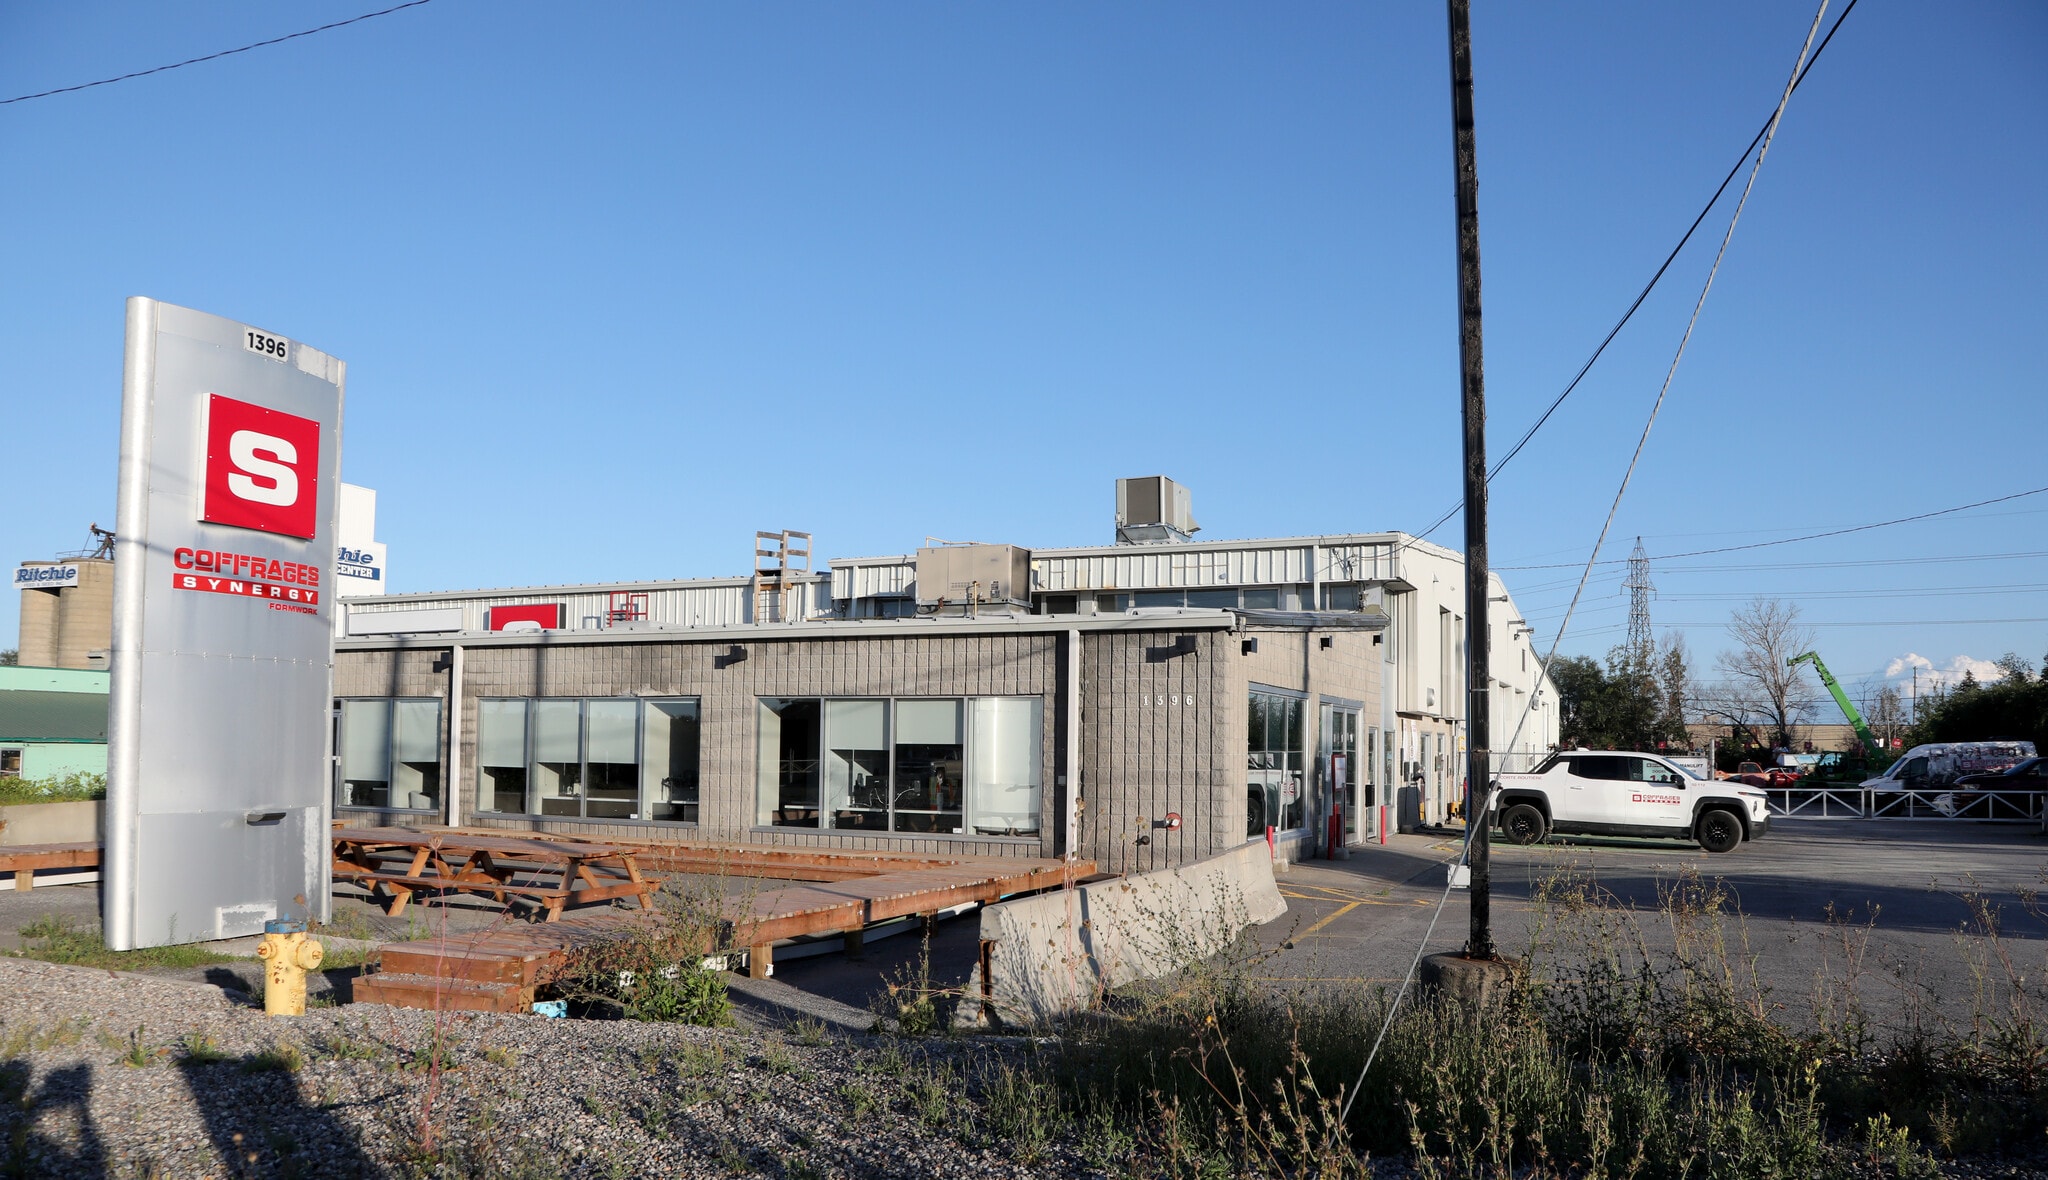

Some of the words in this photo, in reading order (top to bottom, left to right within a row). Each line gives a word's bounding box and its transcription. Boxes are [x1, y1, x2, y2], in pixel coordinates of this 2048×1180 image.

[248, 332, 286, 358] 1396
[228, 429, 299, 507] S
[174, 547, 319, 587] COFFRAGES
[337, 547, 374, 565] hie
[15, 566, 76, 583] Ritchie
[183, 576, 314, 602] SYNERGY
[269, 603, 318, 615] FORMWORK
[1143, 695, 1193, 706] 1396
